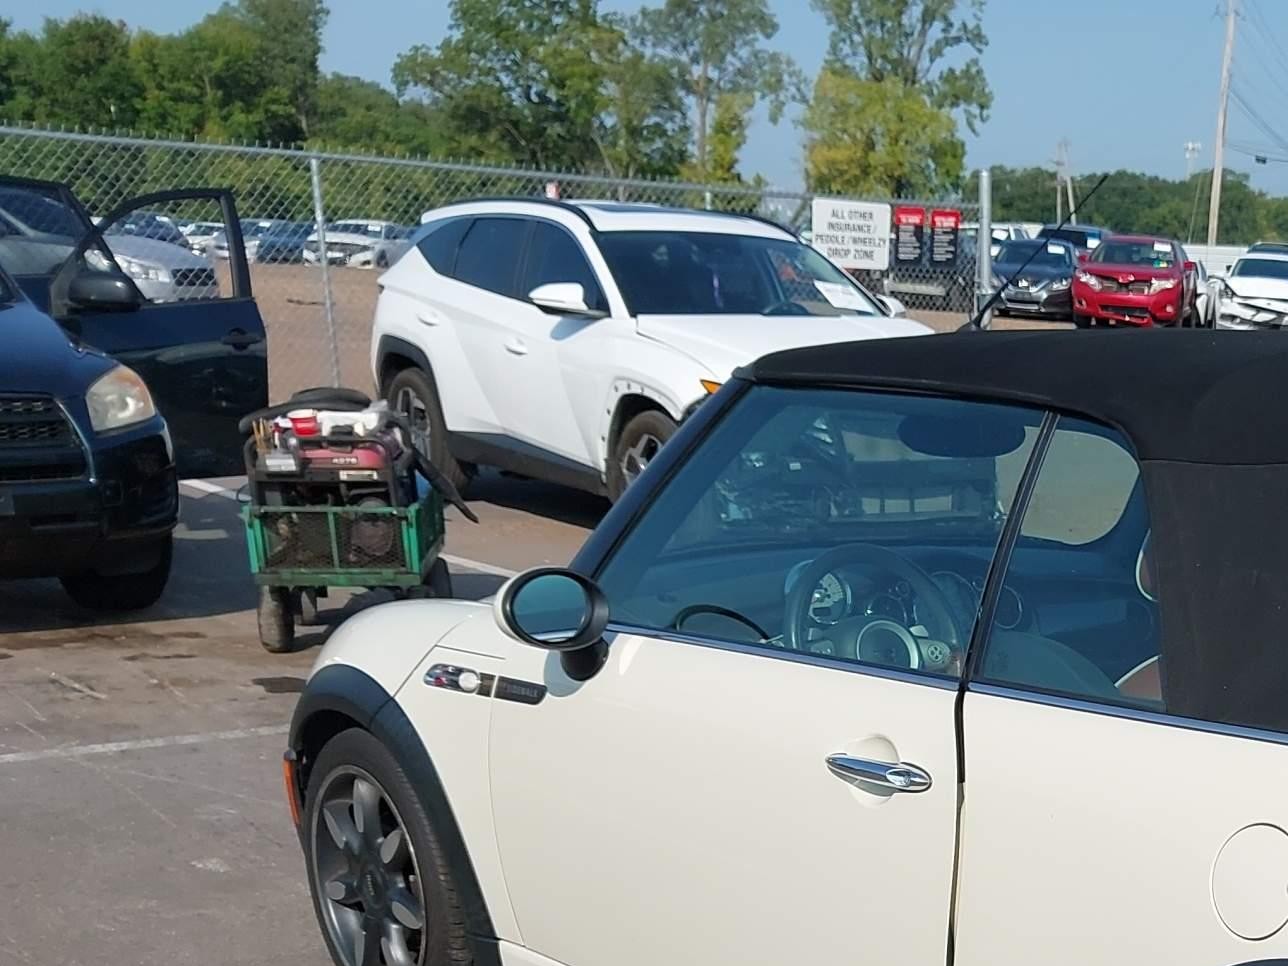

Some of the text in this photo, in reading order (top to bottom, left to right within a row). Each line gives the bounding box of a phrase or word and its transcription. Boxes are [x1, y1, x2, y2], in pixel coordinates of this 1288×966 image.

[831, 209, 873, 221] ALL OTHER
[827, 247, 875, 261] DROP ZONE
